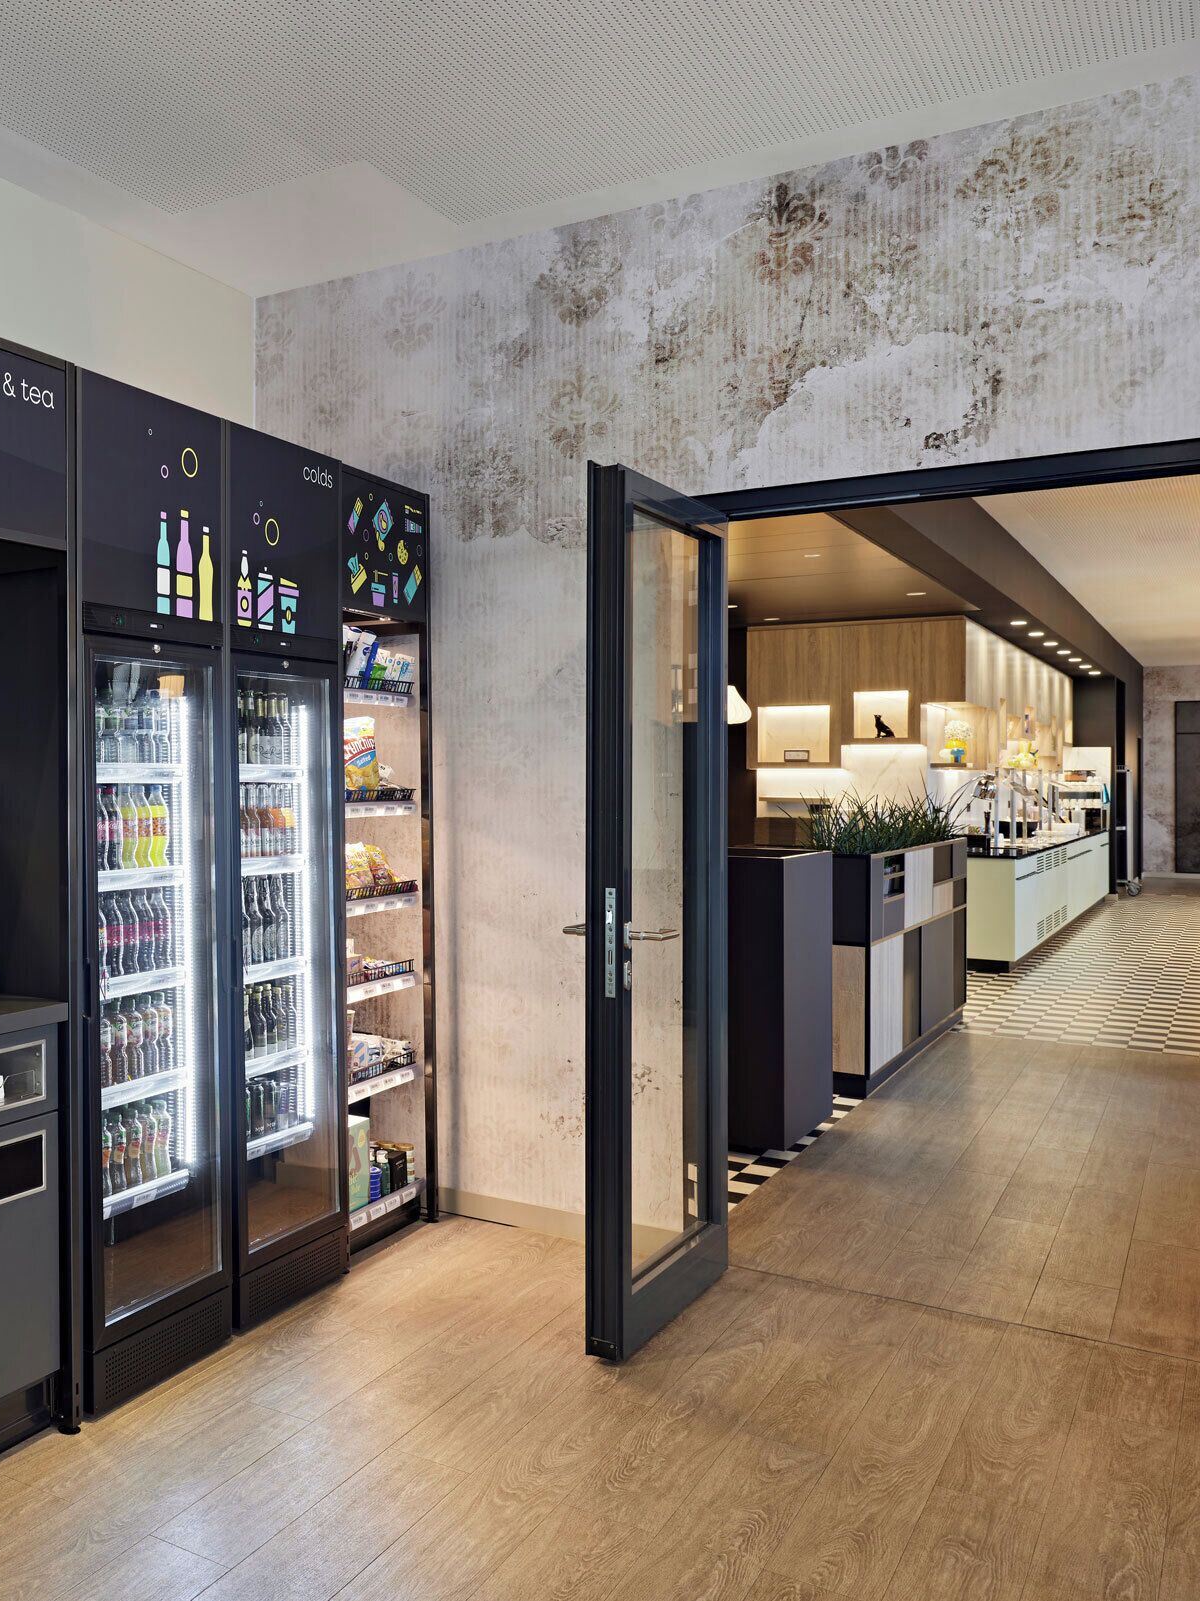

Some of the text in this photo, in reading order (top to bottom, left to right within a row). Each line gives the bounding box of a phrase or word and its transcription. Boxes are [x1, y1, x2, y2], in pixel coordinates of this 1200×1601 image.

[2, 372, 17, 398] &
[20, 378, 55, 409] tea
[302, 466, 334, 489] colds
